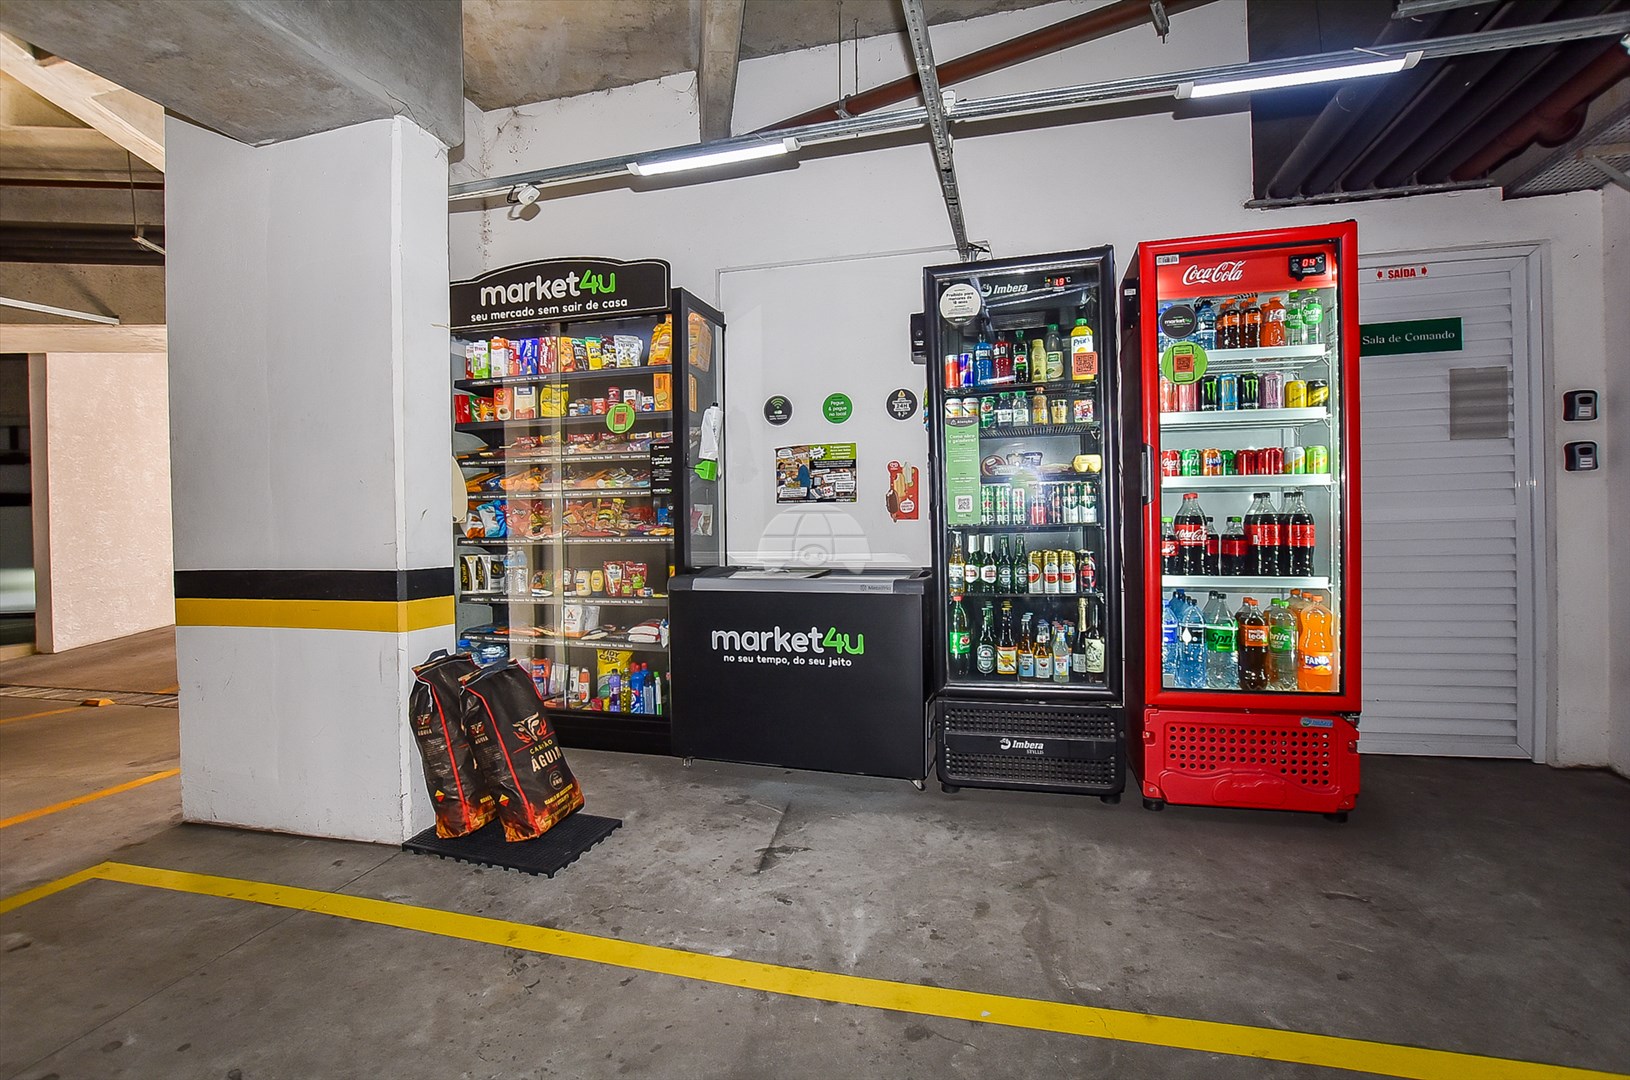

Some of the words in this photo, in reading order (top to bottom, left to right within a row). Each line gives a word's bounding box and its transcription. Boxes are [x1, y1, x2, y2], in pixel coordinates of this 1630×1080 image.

[1182, 260, 1247, 286] Coca-Cola
[1388, 267, 1416, 279] SAÍDA
[480, 269, 616, 306] market4u
[993, 283, 1028, 295] Imbera
[470, 311, 488, 322] seu
[490, 307, 535, 320] mercado
[537, 305, 559, 317] sem
[562, 301, 583, 313] sair
[585, 299, 599, 311] de
[602, 297, 628, 309] casa
[1362, 334, 1385, 345] Sala
[1388, 332, 1401, 343] de
[1404, 329, 1455, 342] Comando
[711, 626, 865, 655] market4u
[601, 649, 620, 657] TIDY
[723, 654, 735, 662] no
[738, 655, 754, 663] seu
[757, 655, 790, 666] tempo,
[793, 656, 805, 665] do
[808, 657, 825, 666] seu
[828, 657, 852, 668] jeito
[1012, 740, 1044, 749] Imbera
[531, 745, 562, 772] ÁGUIA
